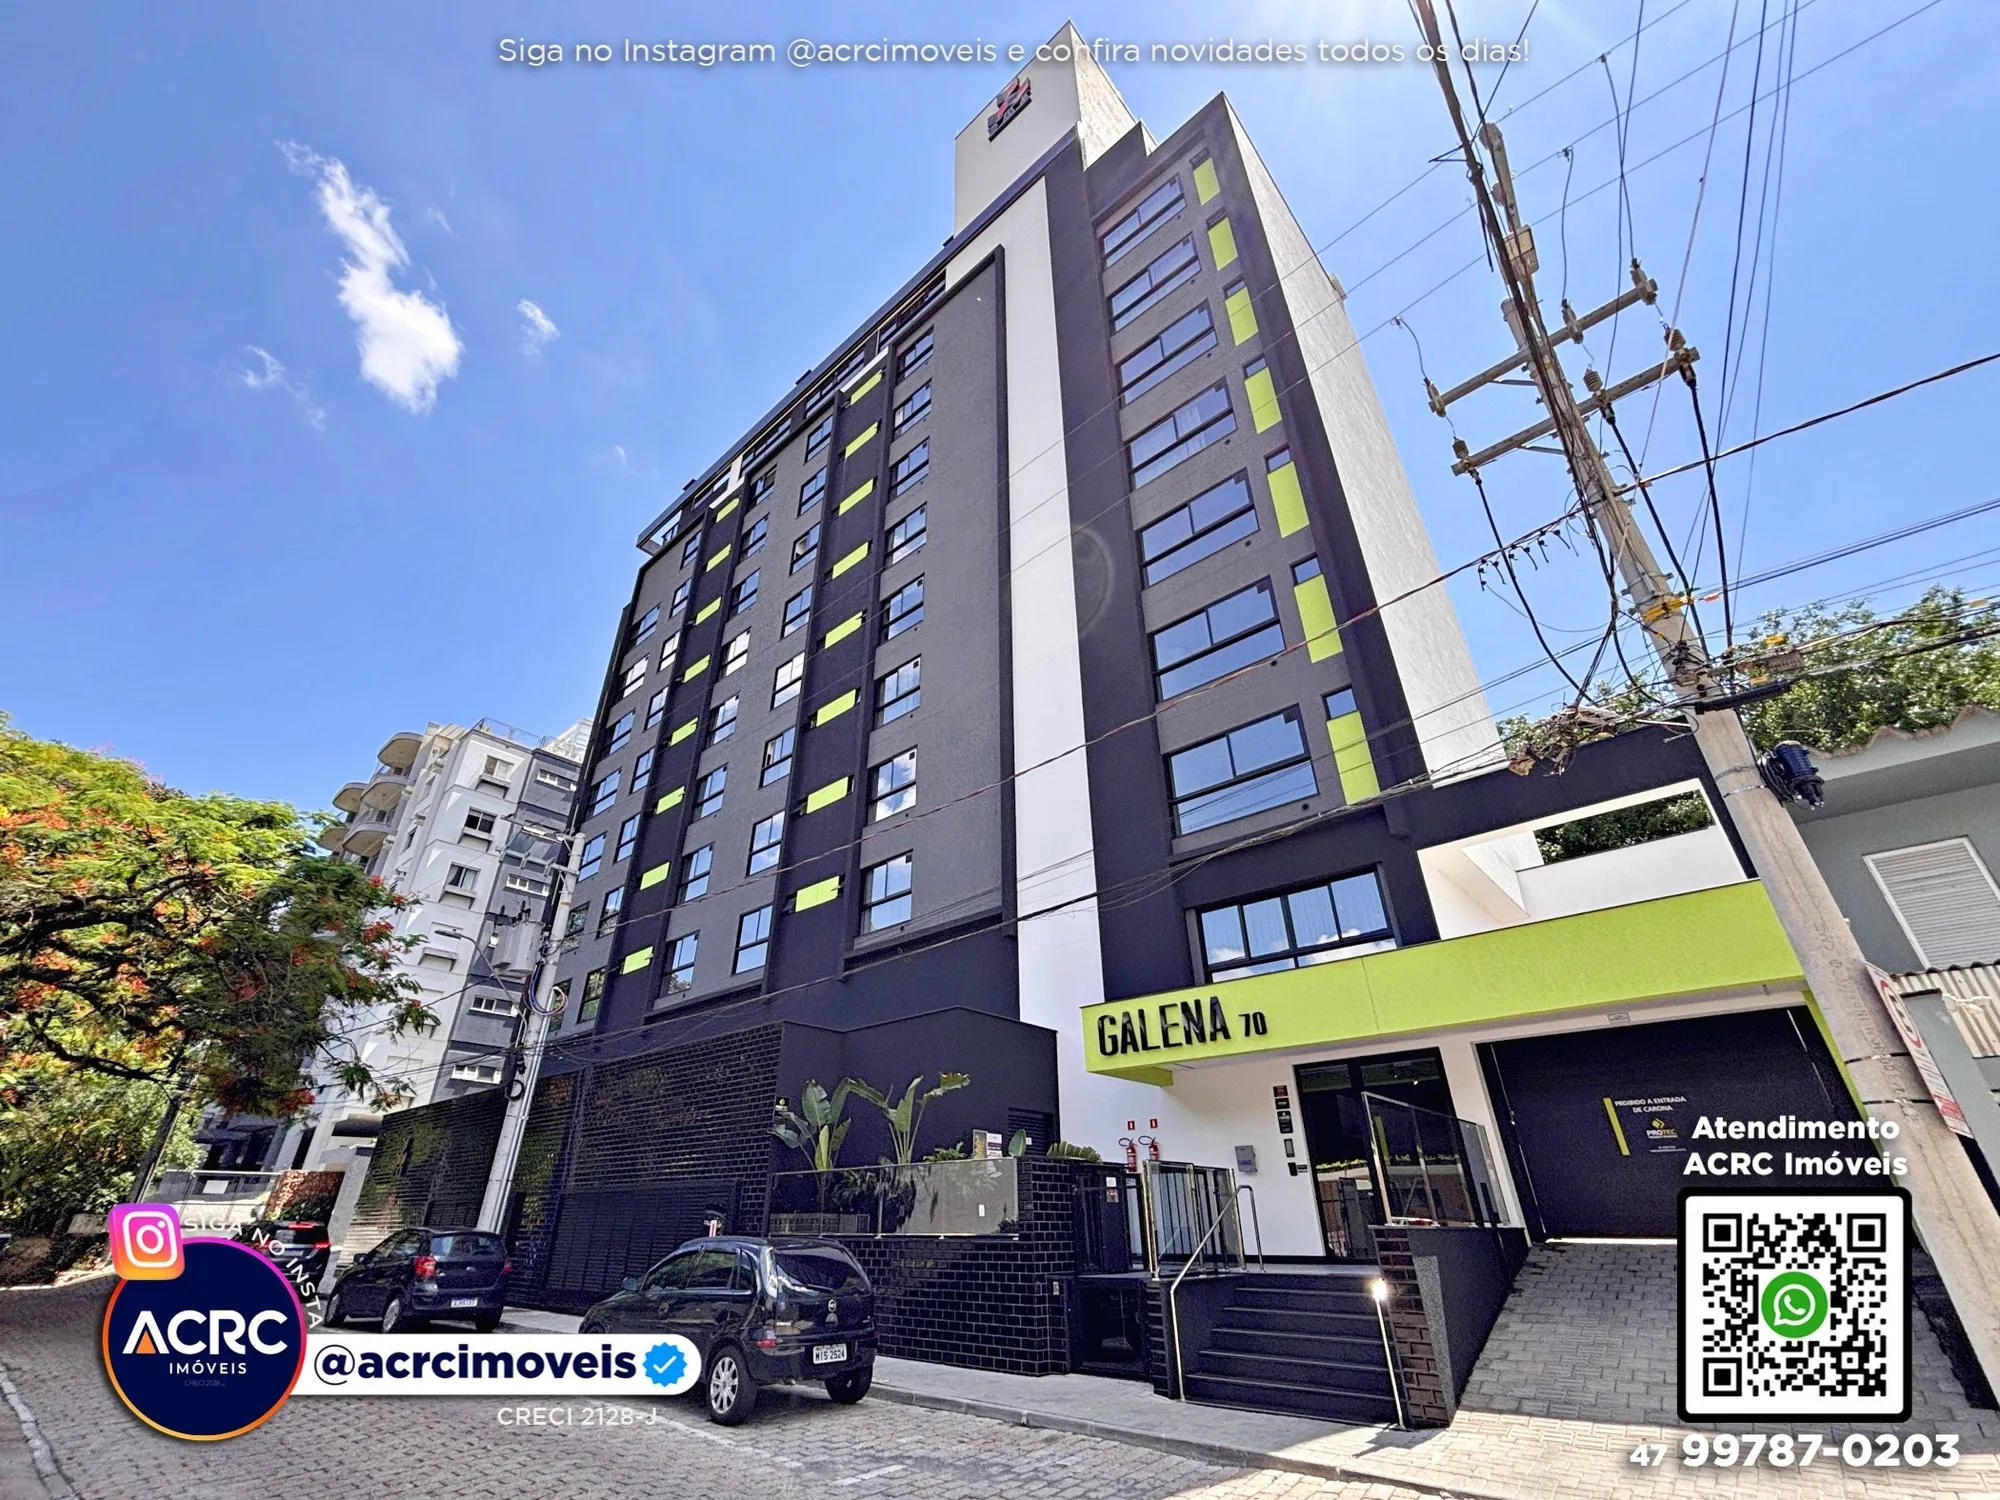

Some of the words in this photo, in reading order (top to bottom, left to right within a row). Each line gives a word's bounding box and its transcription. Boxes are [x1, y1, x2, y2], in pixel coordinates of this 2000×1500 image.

[1098, 996, 1231, 1056] GALENA
[1238, 1011, 1268, 1037] 70
[1614, 1098, 1646, 1107] PROIBIDO
[1653, 1096, 1688, 1104] ENTRADA
[1643, 1105, 1674, 1113] CARONA
[1646, 1128, 1677, 1136] PROTEC
